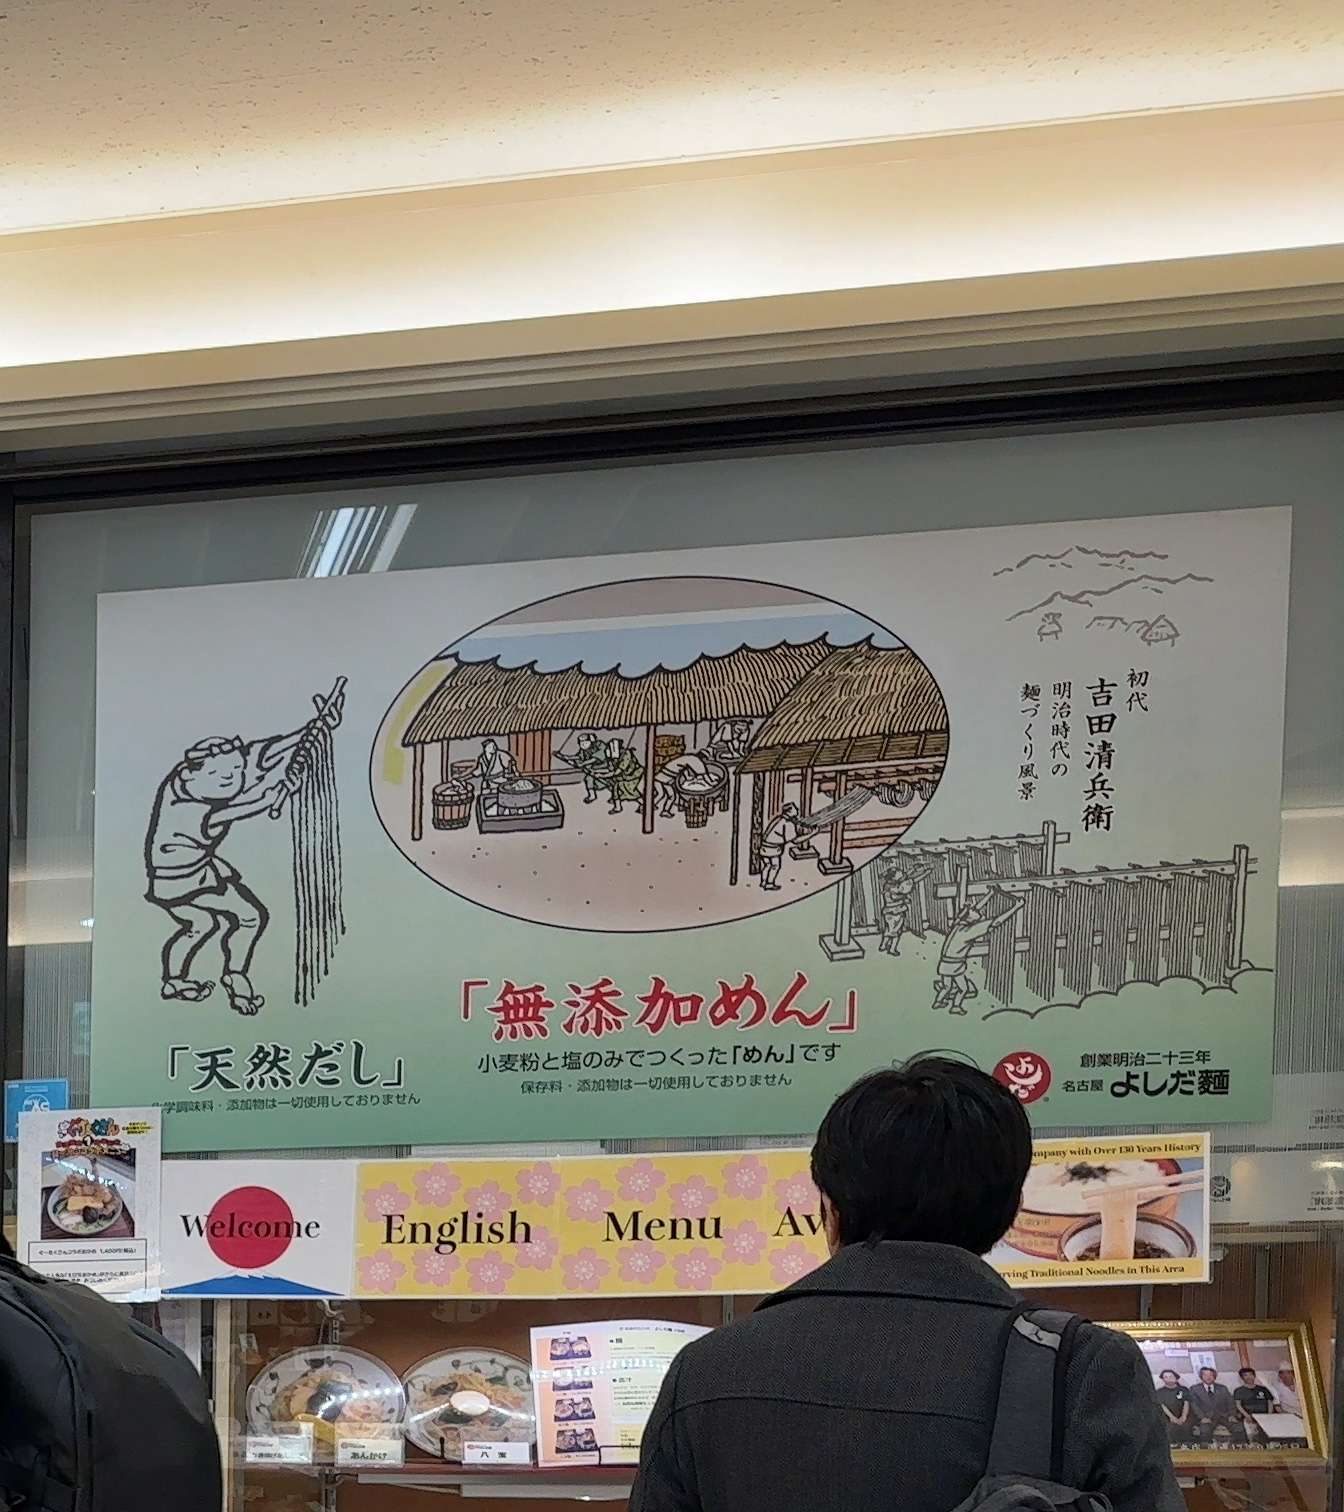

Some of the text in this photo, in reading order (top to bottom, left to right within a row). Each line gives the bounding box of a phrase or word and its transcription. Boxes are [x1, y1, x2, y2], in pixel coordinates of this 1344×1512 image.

[1126, 668, 1150, 713] 初代
[1050, 681, 1072, 776] 明治時代の
[1082, 677, 1118, 832] 吉田清兵衛
[462, 971, 856, 1041] 「無添加めん」
[170, 1040, 403, 1091] 「天然だし」
[478, 1042, 841, 1073] 小麦粉と塩のみでつくった「めん」です
[1080, 1049, 1212, 1068] 創業明治二十三年
[1062, 1079, 1104, 1093] 名古屋
[1031, 1142, 1202, 1160] mpany with Over 130 Years History
[180, 1211, 321, 1240] Welcome
[381, 1209, 533, 1255] English
[602, 1210, 723, 1242] Menu
[998, 1265, 1185, 1280] rving Traditional Noodles in This Area
